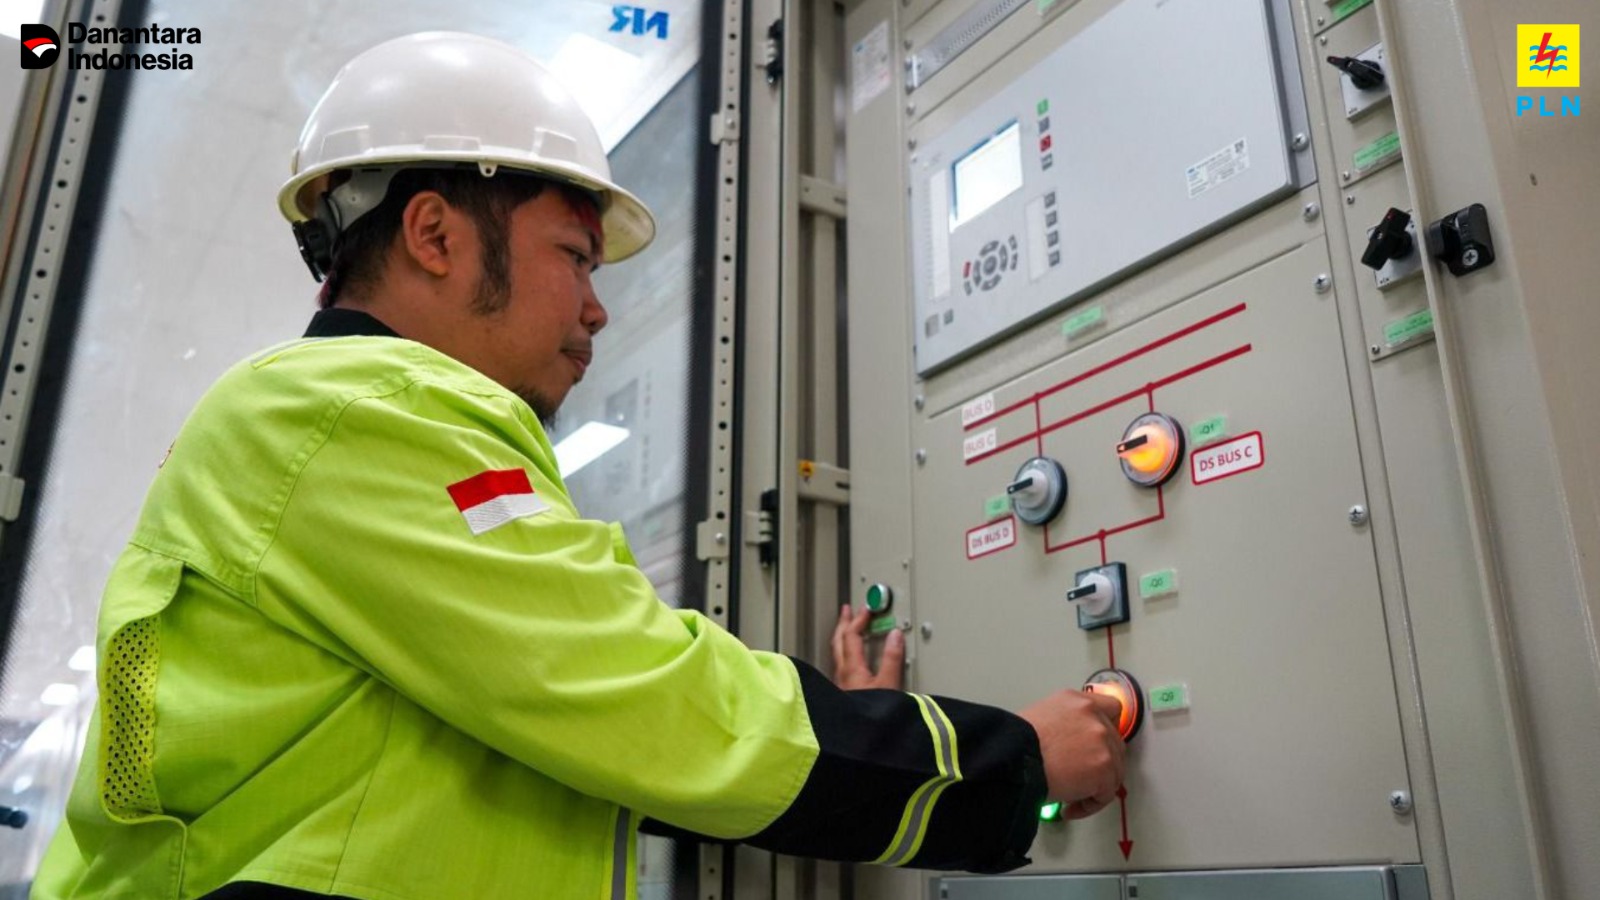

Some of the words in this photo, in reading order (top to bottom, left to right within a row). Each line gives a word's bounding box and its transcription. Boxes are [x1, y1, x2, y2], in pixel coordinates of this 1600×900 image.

[964, 403, 983, 421] BUS
[965, 436, 985, 454] BUS
[986, 433, 995, 447] C
[1199, 457, 1214, 472] DS
[1217, 449, 1242, 466] BUS
[1244, 445, 1253, 458] C
[984, 529, 1001, 545] BUS
